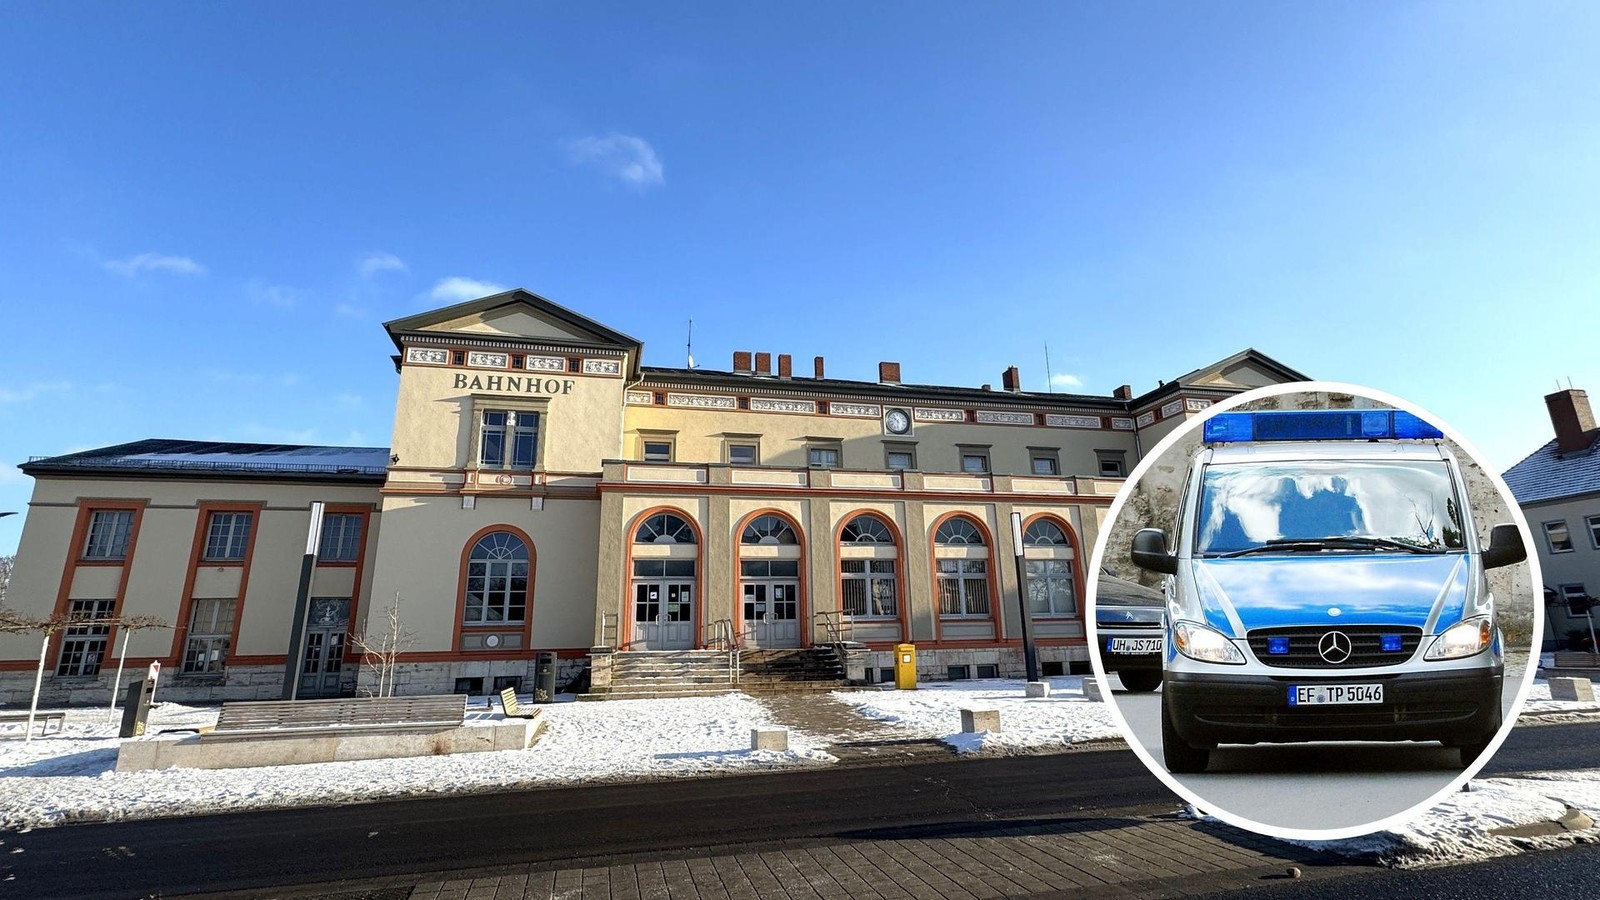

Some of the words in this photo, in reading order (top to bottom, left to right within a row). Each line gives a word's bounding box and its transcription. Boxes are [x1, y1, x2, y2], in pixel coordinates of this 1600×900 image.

[453, 374, 575, 394] BAHNHOF
[1112, 640, 1126, 651] UH
[1131, 640, 1144, 651] JS
[1297, 687, 1315, 703] EF
[1326, 687, 1343, 702] TP
[1347, 685, 1381, 702] 5046
